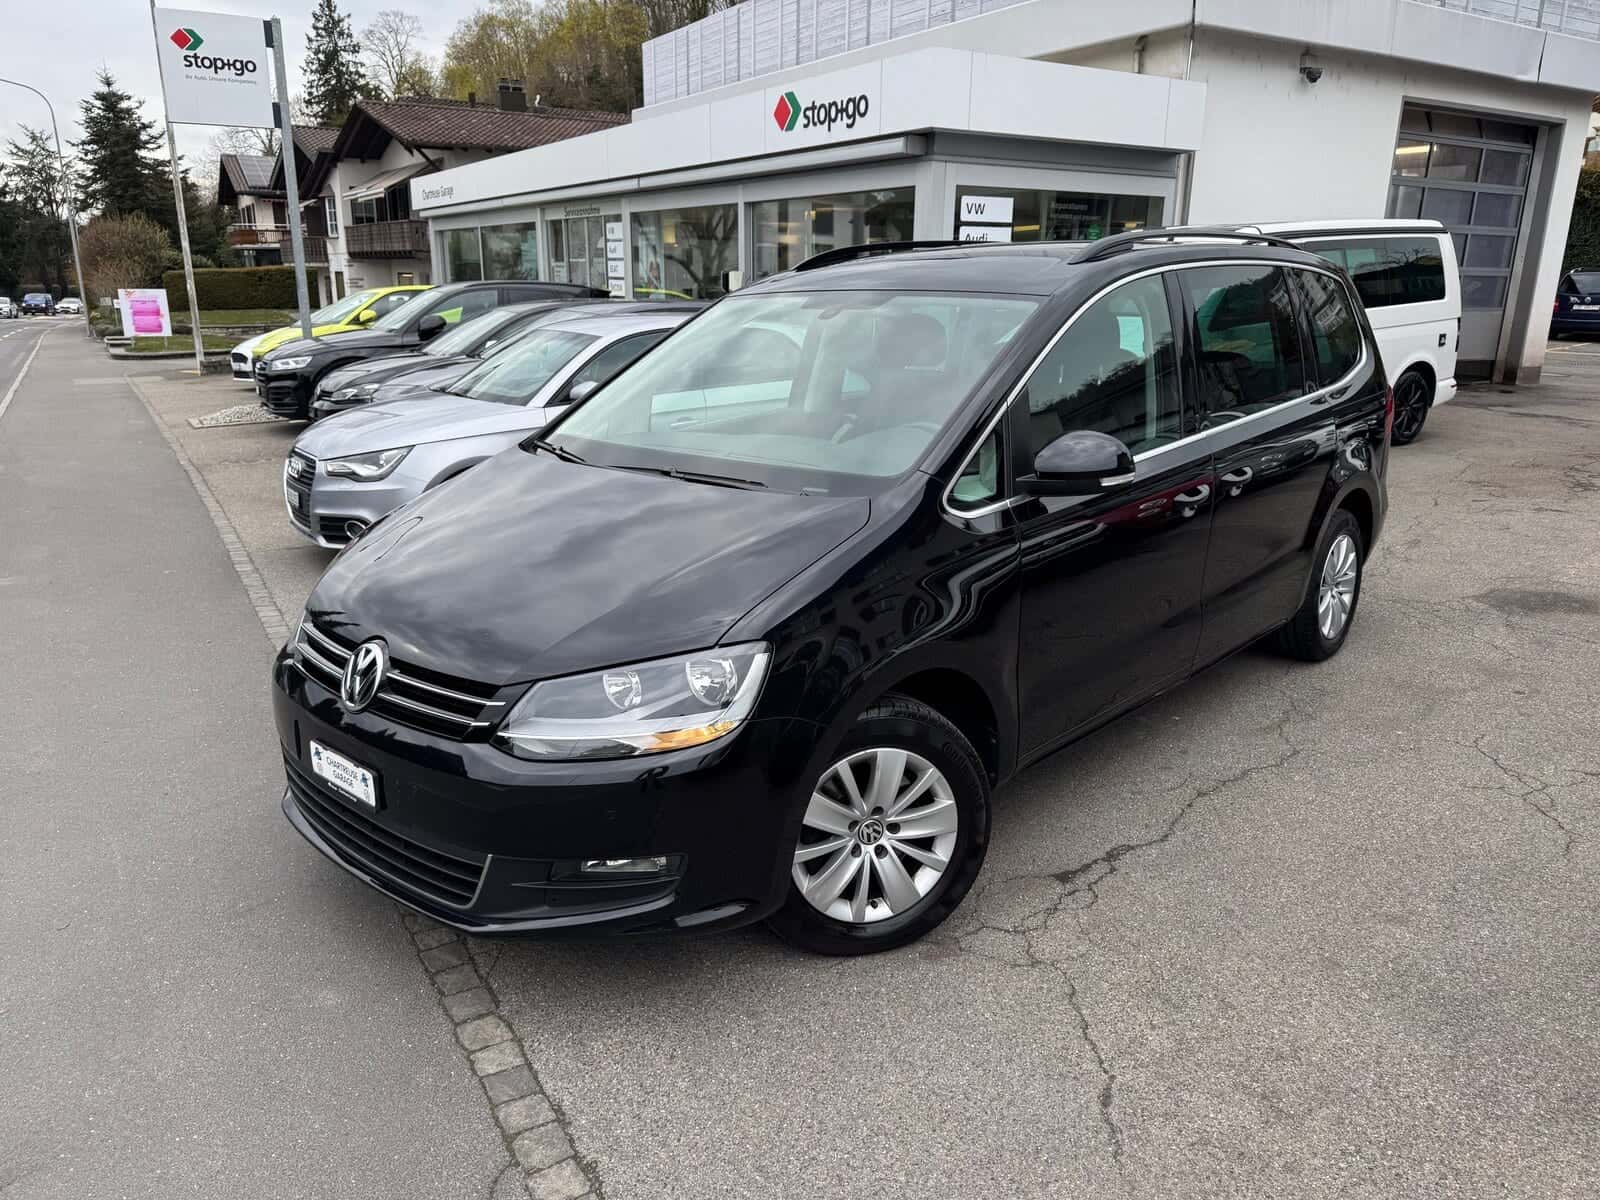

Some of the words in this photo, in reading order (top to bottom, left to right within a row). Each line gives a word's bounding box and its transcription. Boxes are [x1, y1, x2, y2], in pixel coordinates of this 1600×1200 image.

[183, 53, 257, 76] stop+go
[803, 94, 869, 132] stop+go
[966, 202, 986, 215] VW
[332, 769, 354, 788] GARAGE
